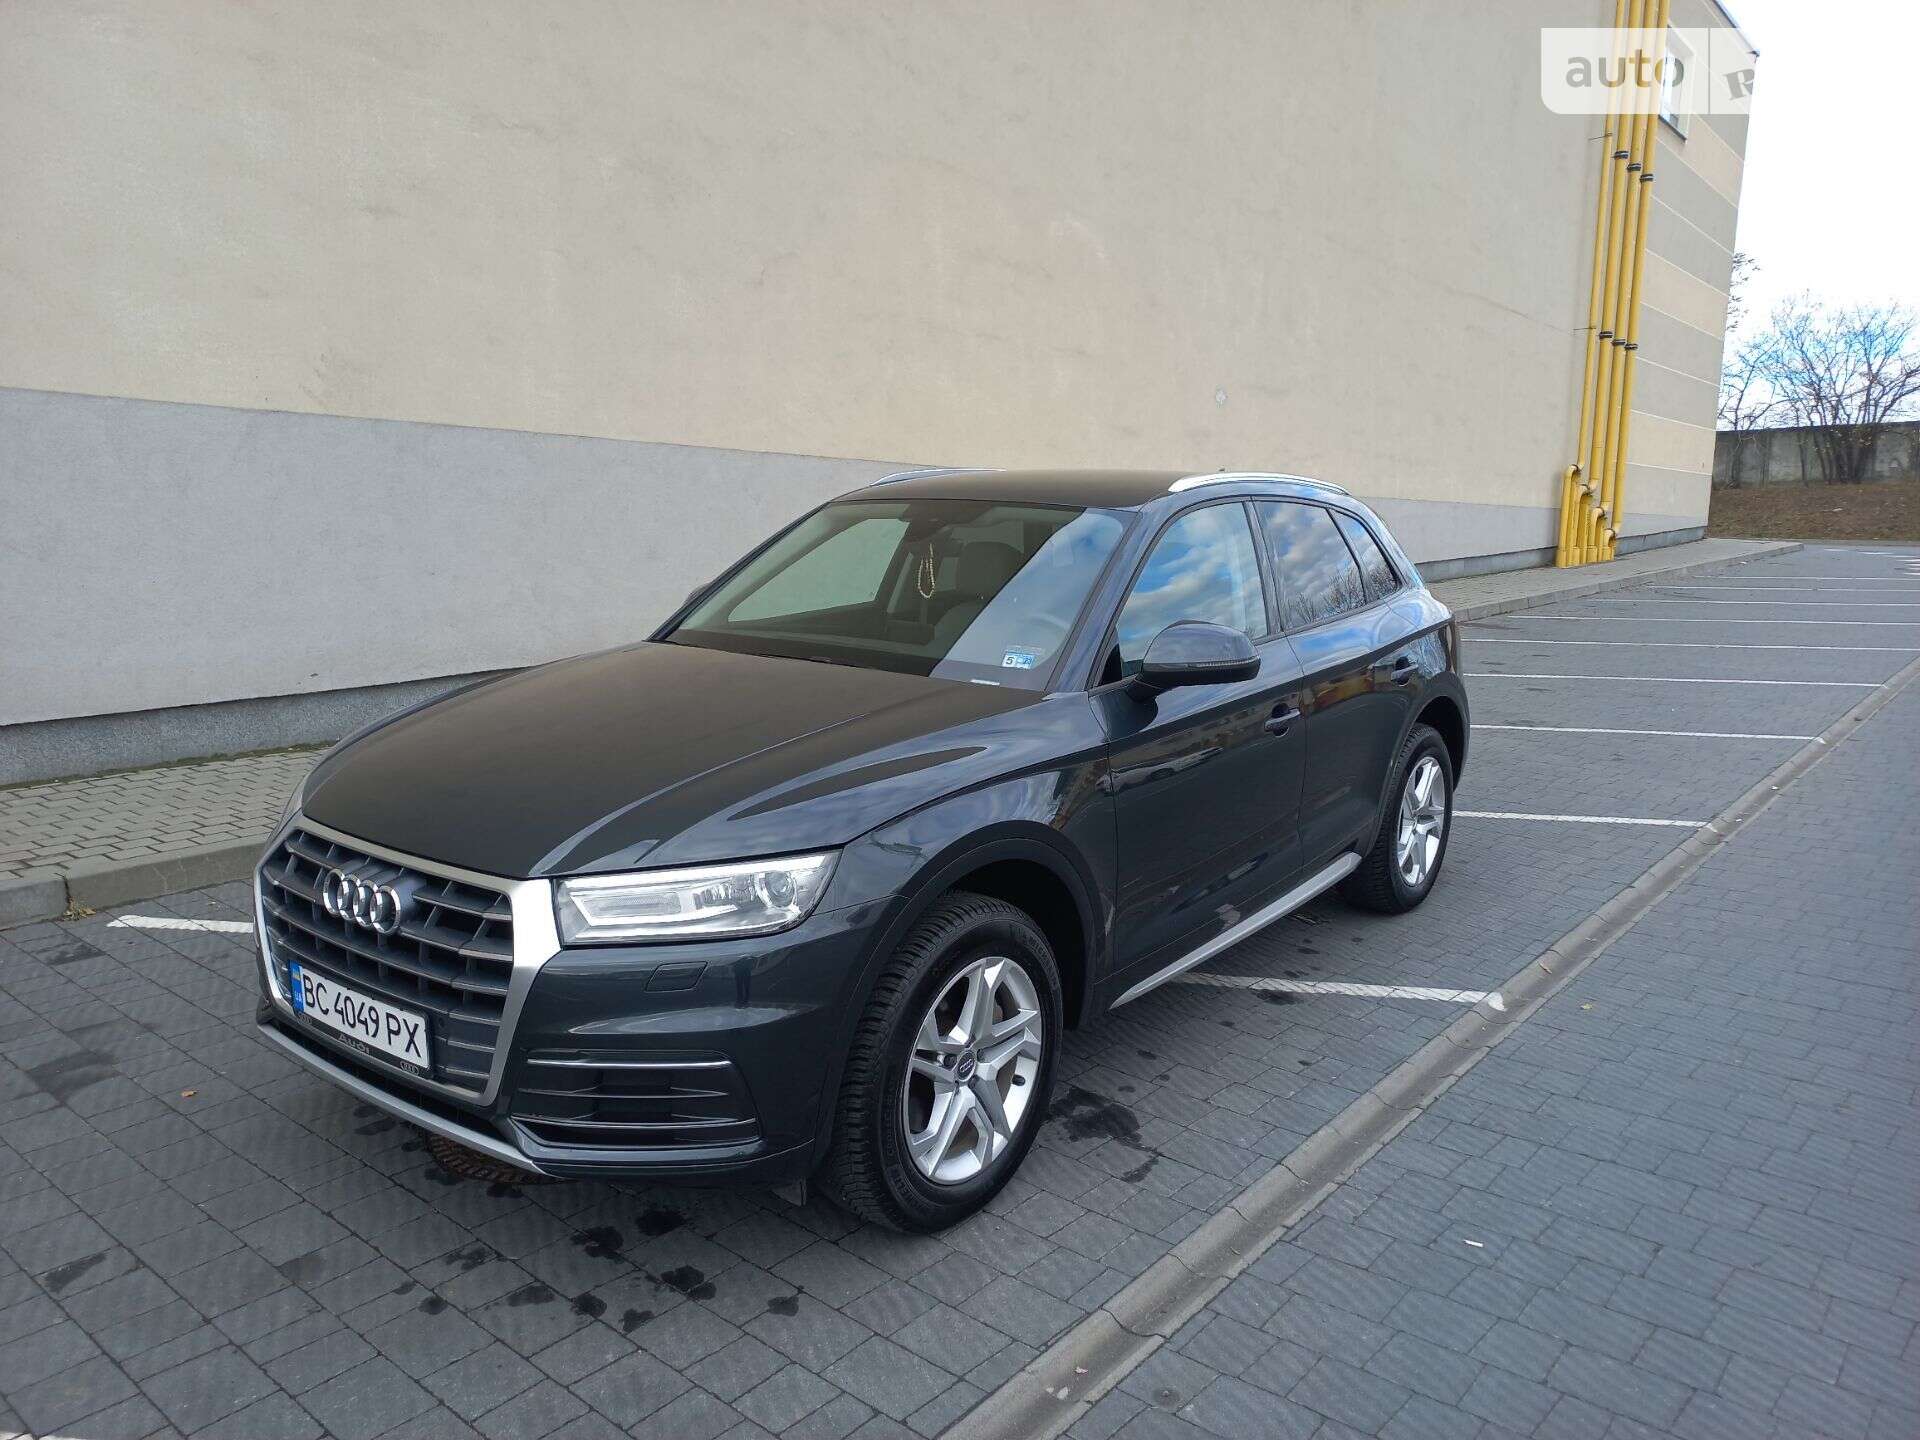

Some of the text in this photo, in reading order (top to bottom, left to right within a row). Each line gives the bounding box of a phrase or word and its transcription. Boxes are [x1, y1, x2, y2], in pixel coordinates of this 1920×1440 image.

[302, 974, 422, 1058] BC 4049 PX
